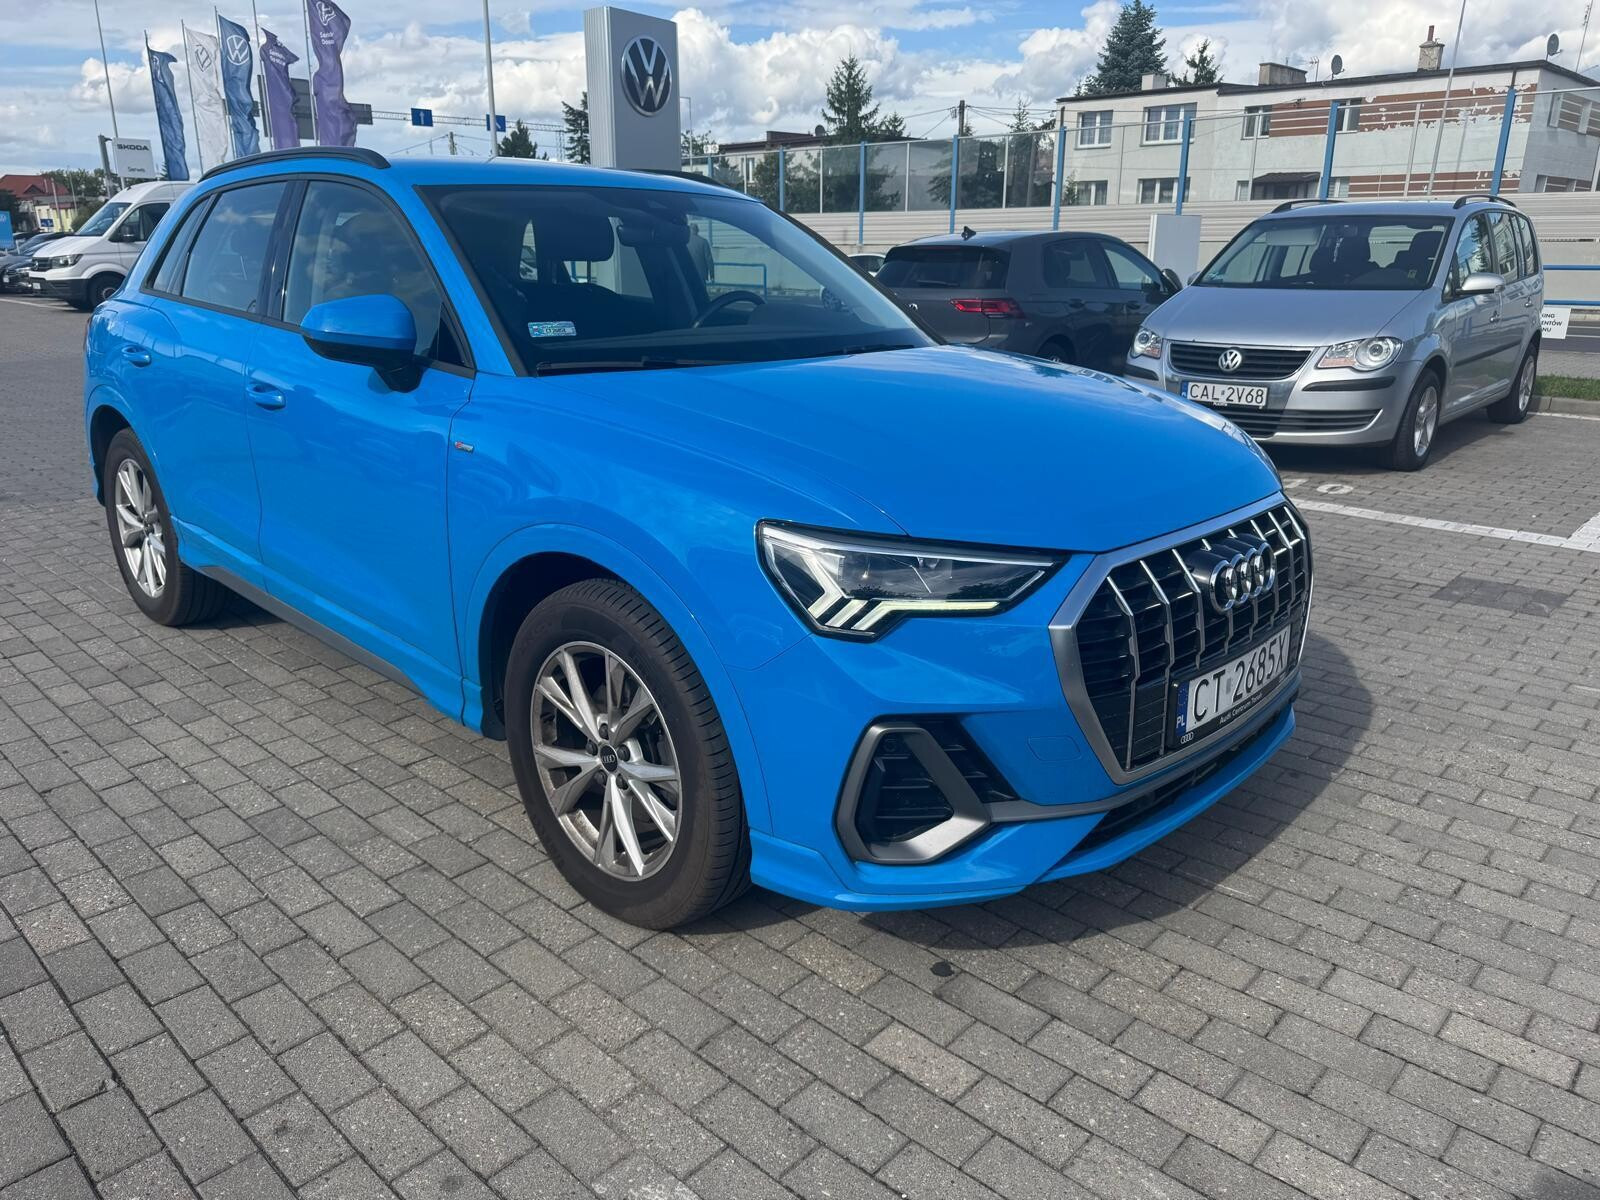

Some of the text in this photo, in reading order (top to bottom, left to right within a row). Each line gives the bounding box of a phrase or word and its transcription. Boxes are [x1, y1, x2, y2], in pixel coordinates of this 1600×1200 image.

[1189, 383, 1265, 405] CAL 2V68
[1193, 631, 1287, 722] CT 2685X
[1175, 714, 1186, 729] PL
